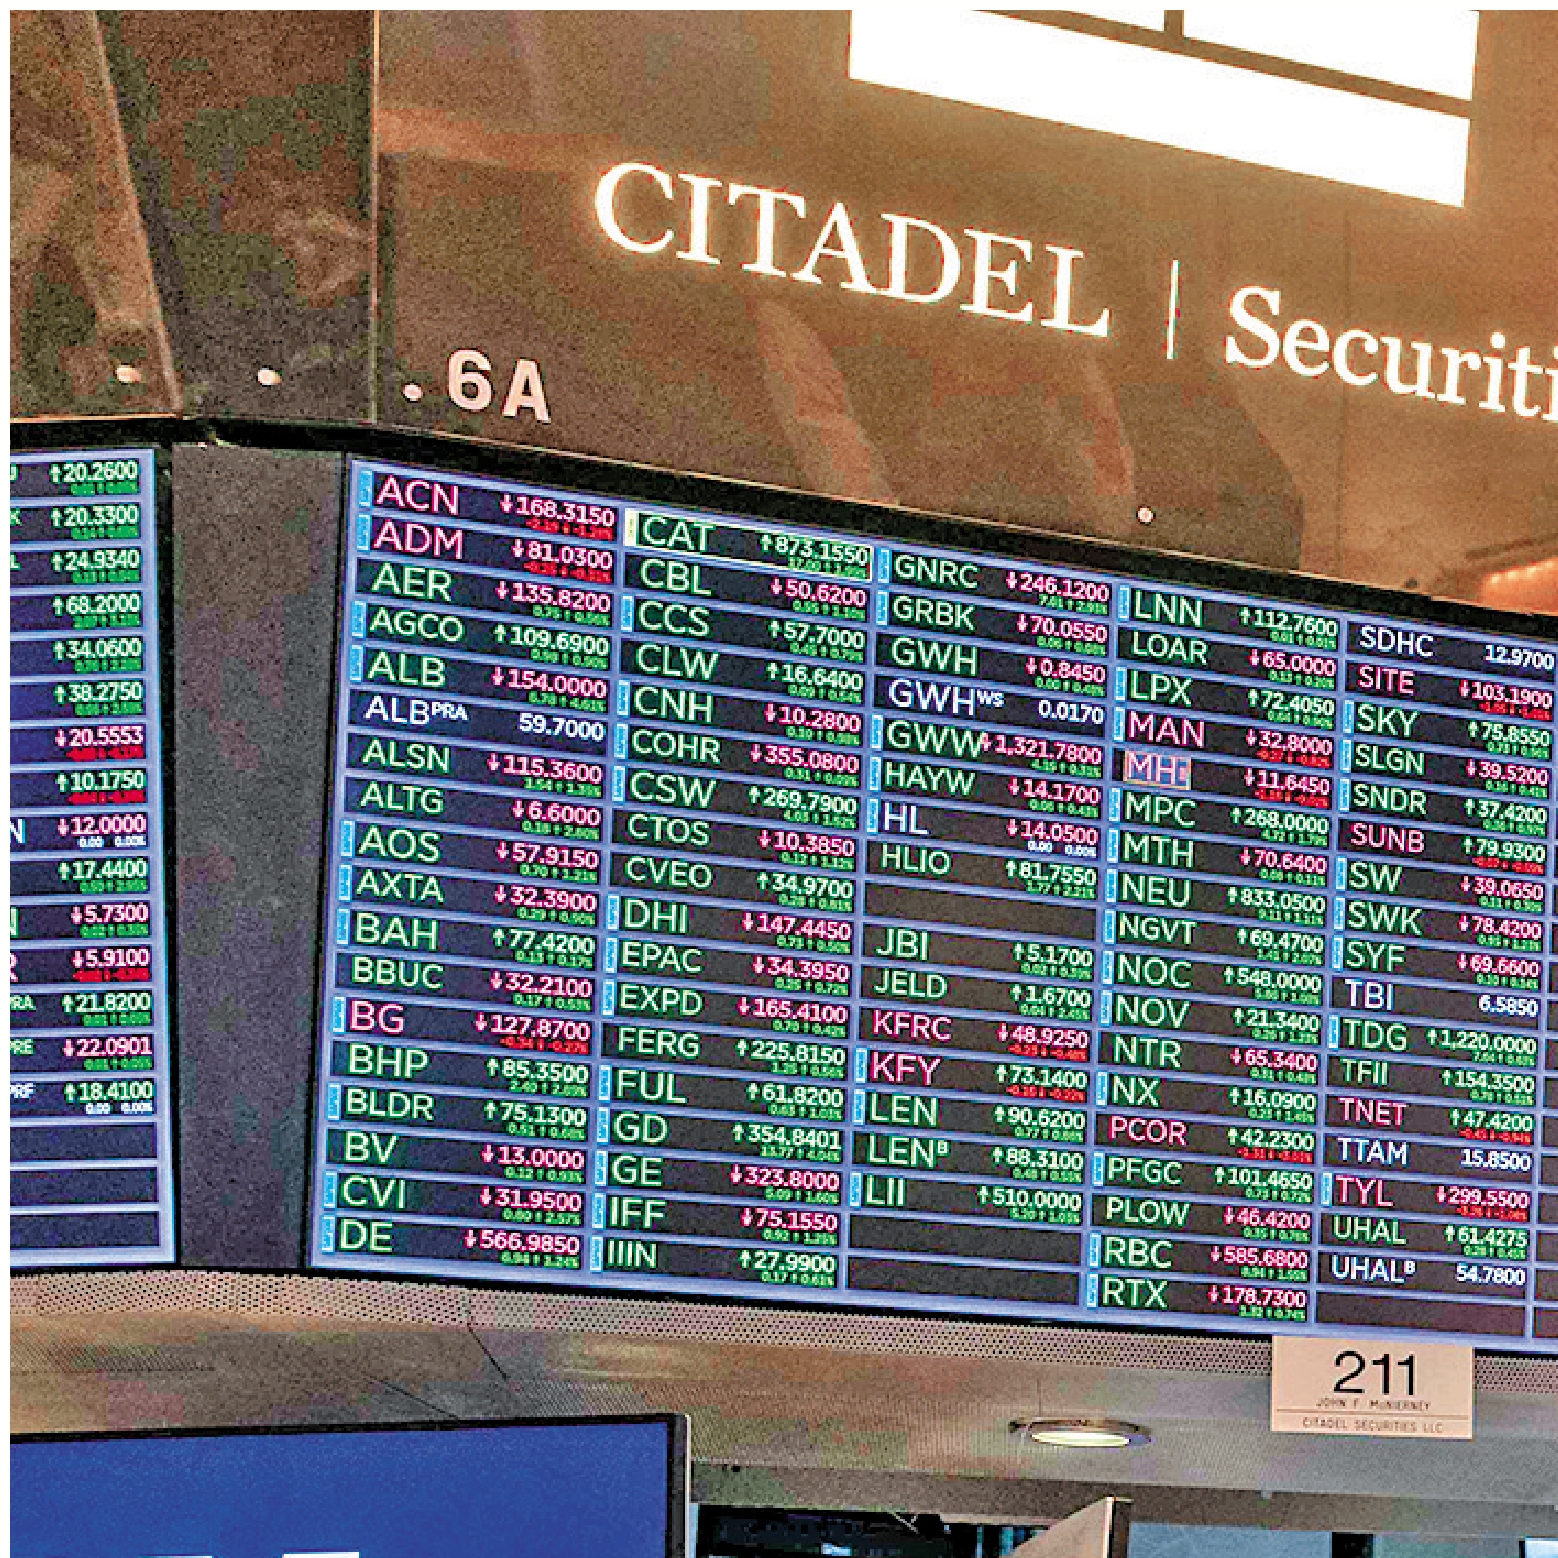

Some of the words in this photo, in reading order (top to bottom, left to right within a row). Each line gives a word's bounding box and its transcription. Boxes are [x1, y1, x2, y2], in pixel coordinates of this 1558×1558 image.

[595, 160, 1110, 338] CITADEL
[448, 348, 551, 422] 6A
[62, 460, 138, 482] 20.2600
[64, 505, 140, 527] 20.3300
[376, 475, 460, 516] ACN
[515, 496, 616, 526] 168.3150
[373, 520, 463, 560] ADM
[528, 541, 614, 569] 81.0300
[642, 516, 715, 552] CAT
[774, 533, 868, 563] 873.1550
[640, 558, 712, 598] CBL
[785, 578, 866, 606] 50.6200
[893, 555, 980, 590] GNRC
[1019, 572, 1110, 603] 246.1200
[369, 605, 464, 643] AGCO
[510, 626, 610, 655] 109.6900
[1134, 592, 1203, 627] LNN
[1254, 610, 1338, 637] 112.7600
[1359, 626, 1434, 657] SDHC
[1485, 644, 1555, 671] 12.9700
[367, 651, 447, 688] ALB
[508, 669, 608, 698] 154.0000
[632, 728, 721, 763] COHR
[764, 747, 860, 774] 355.0800
[348, 1042, 429, 1078] BHP
[502, 1060, 589, 1084] 85.3500
[78, 1080, 153, 1101] 18.4100
[869, 1092, 937, 1127] LEN
[1007, 1105, 1086, 1130] 90.6200
[338, 1217, 393, 1253] DE
[479, 1230, 581, 1254] 566.9850
[1102, 1279, 1168, 1308] RTX
[1221, 1285, 1306, 1308] 178.7300
[1333, 1350, 1415, 1395] 211
[1303, 1417, 1348, 1429] CITADEL
[1354, 1419, 1417, 1432] SECURITIES
